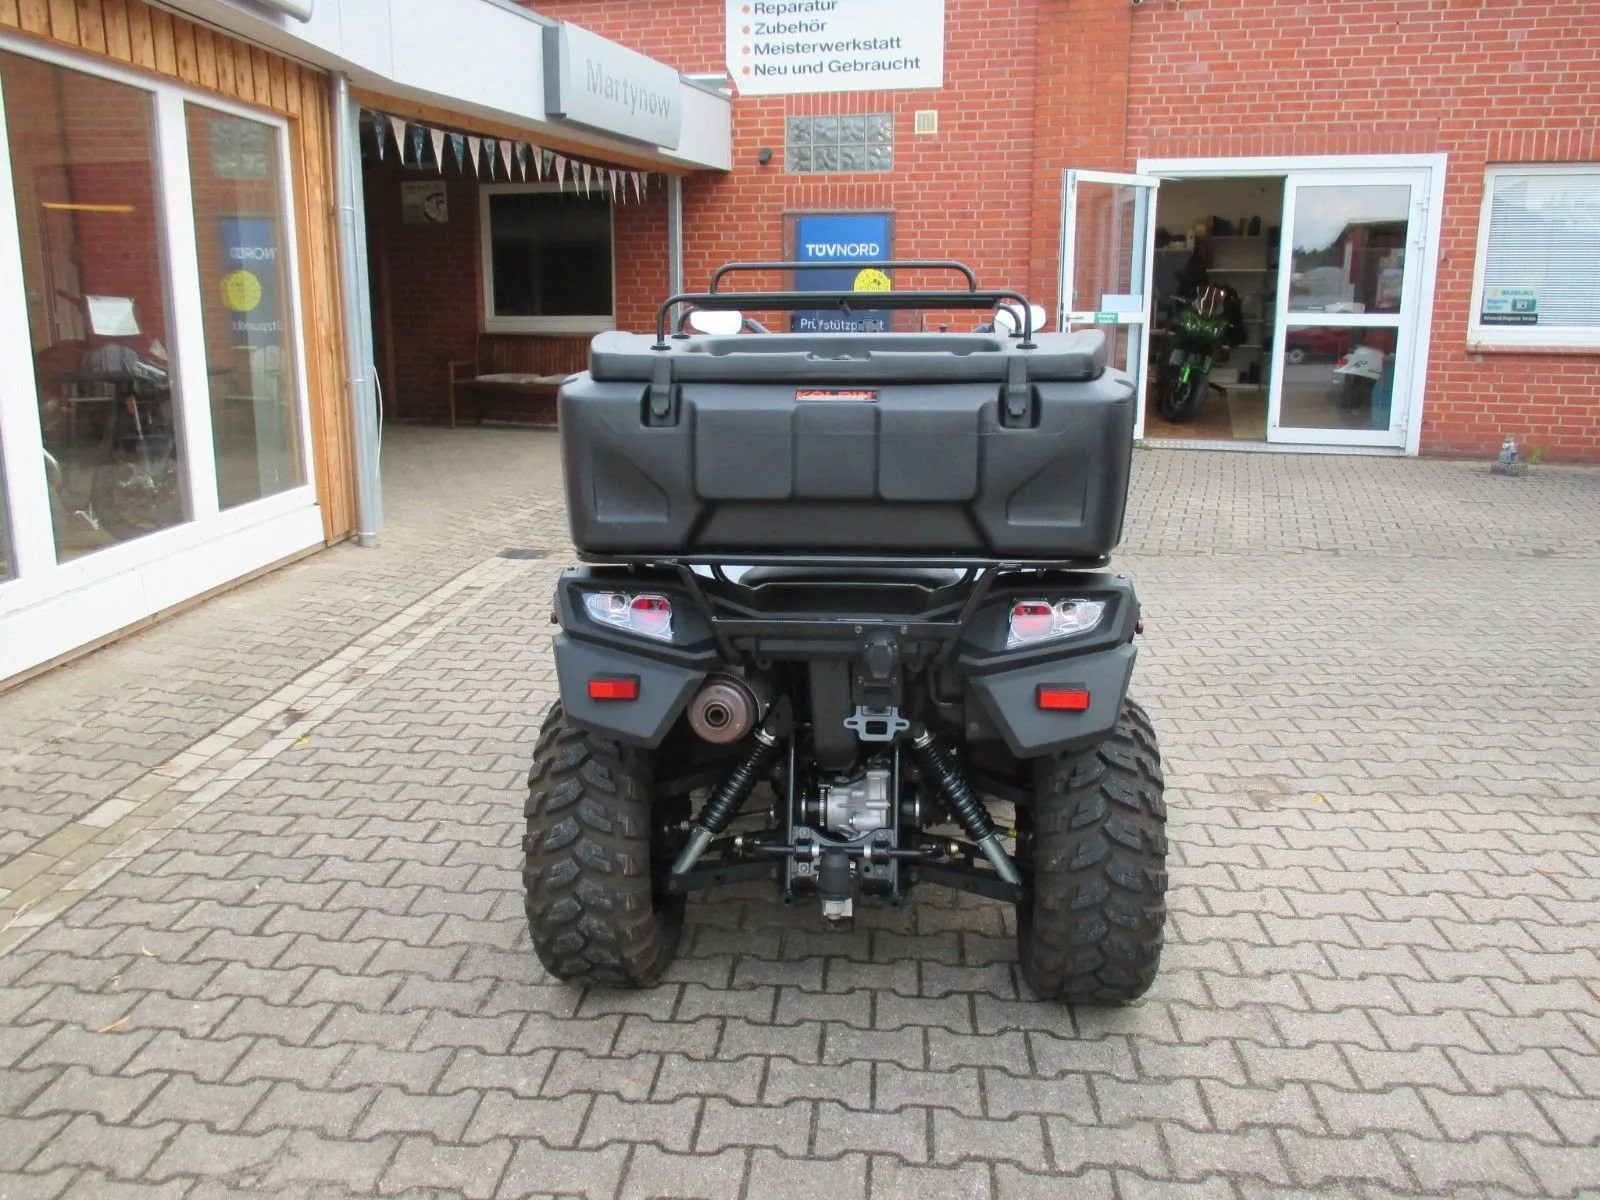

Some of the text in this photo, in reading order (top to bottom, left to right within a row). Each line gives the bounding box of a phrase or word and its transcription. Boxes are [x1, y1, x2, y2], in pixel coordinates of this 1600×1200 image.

[753, 0, 838, 16] Reparatur
[754, 19, 827, 36] Zubehör
[753, 36, 902, 56] Meisterwerkstatt
[753, 56, 921, 77] Neu und Gebraucht
[586, 58, 671, 119] Martynow
